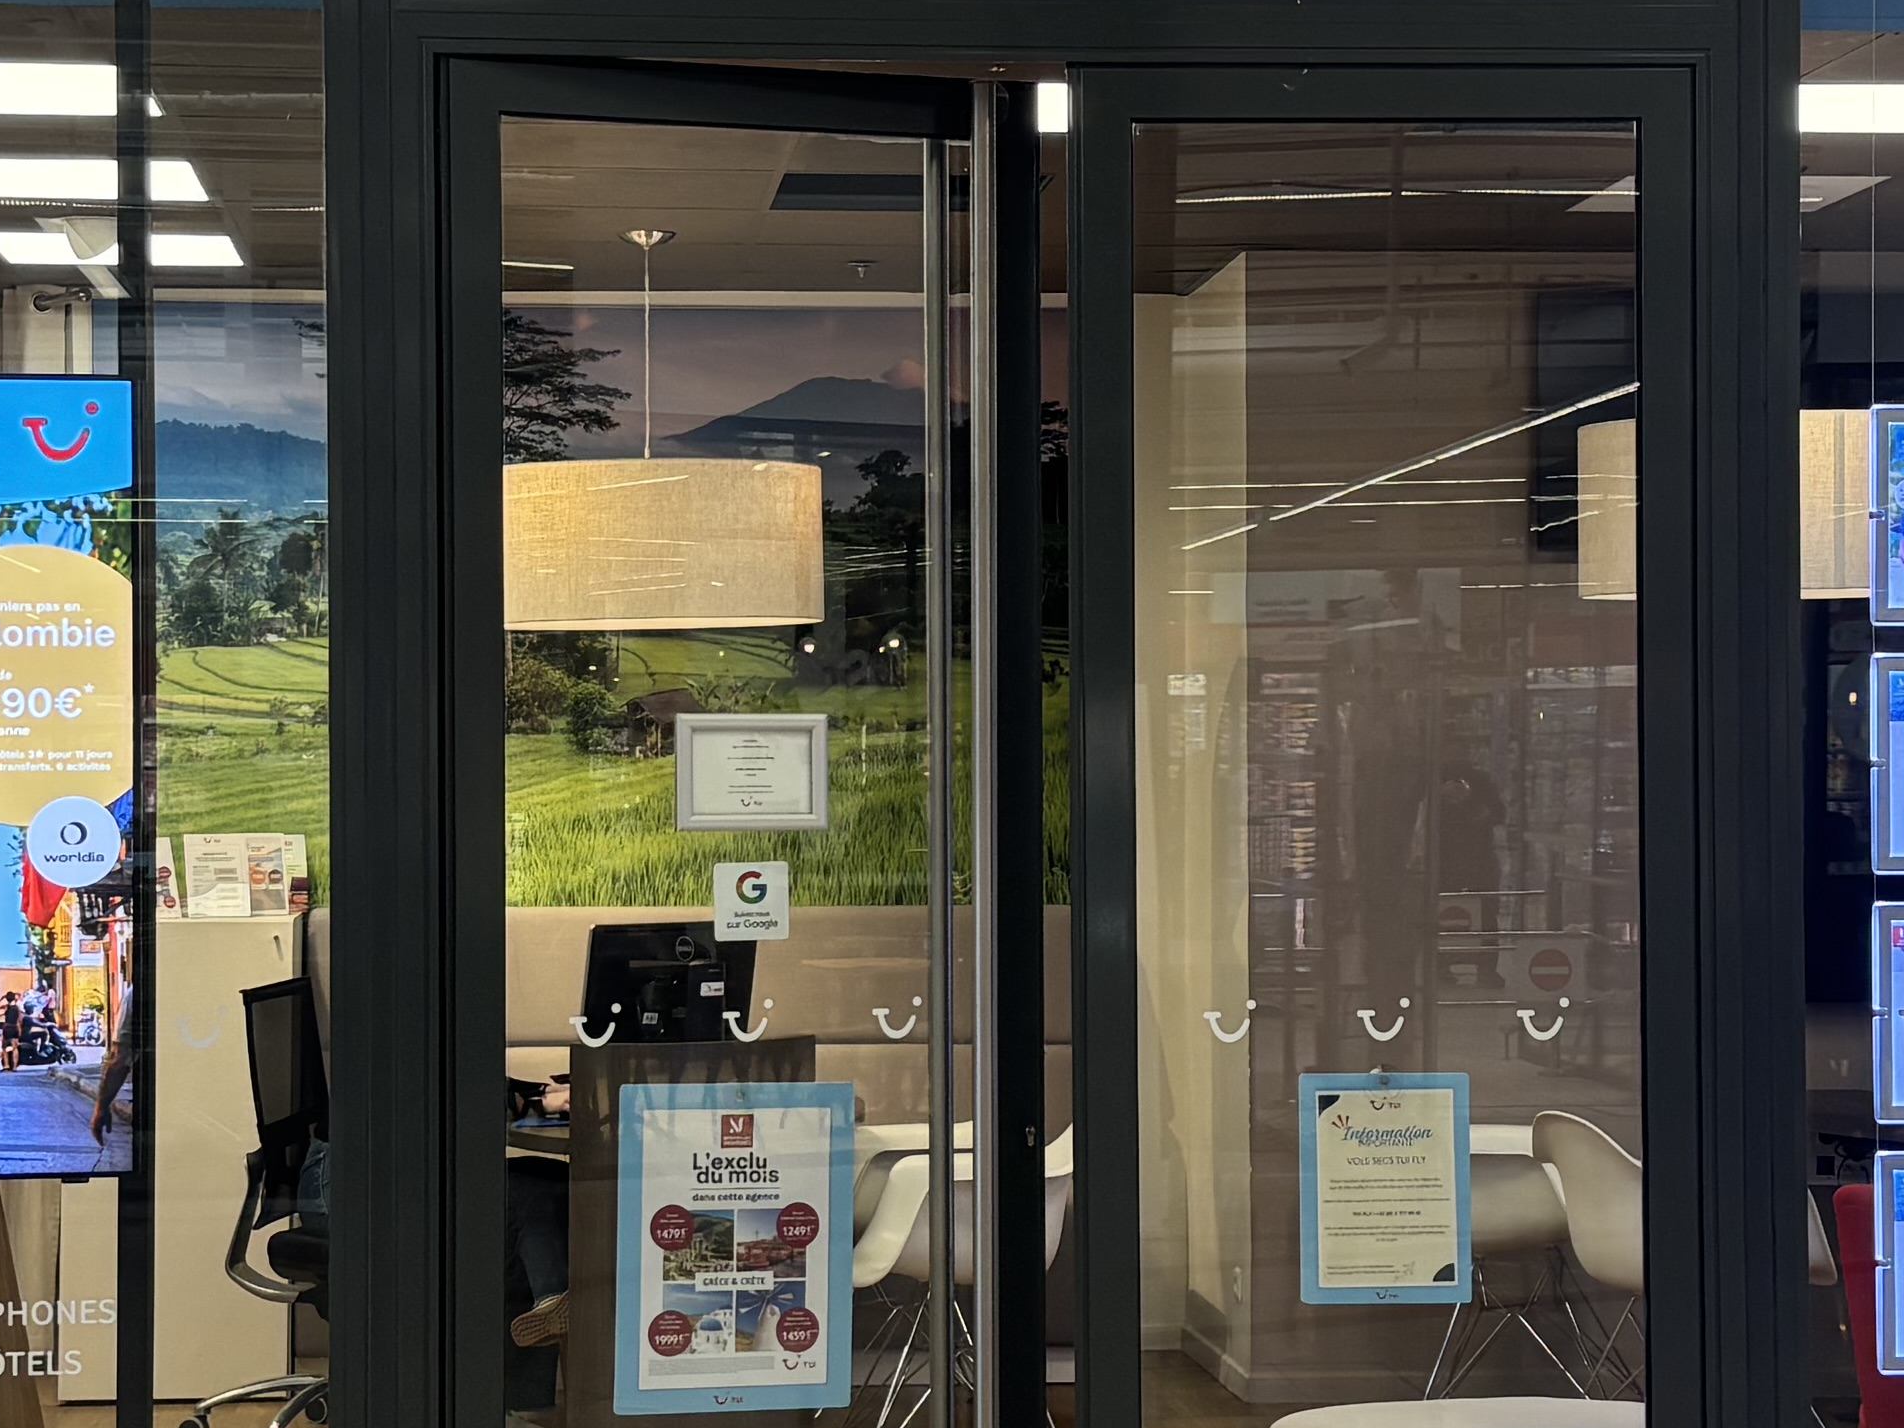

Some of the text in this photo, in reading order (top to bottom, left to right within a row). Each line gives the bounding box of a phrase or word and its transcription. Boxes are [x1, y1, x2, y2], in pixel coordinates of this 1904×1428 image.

[36, 603, 60, 614] pas
[64, 603, 81, 612] en
[44, 851, 105, 863] worldia
[743, 919, 778, 930] Google
[1341, 1125, 1433, 1142] Information
[693, 1152, 768, 1171] L'exclu
[696, 1169, 780, 1184] du mois
[692, 1193, 780, 1203] dans cette agence
